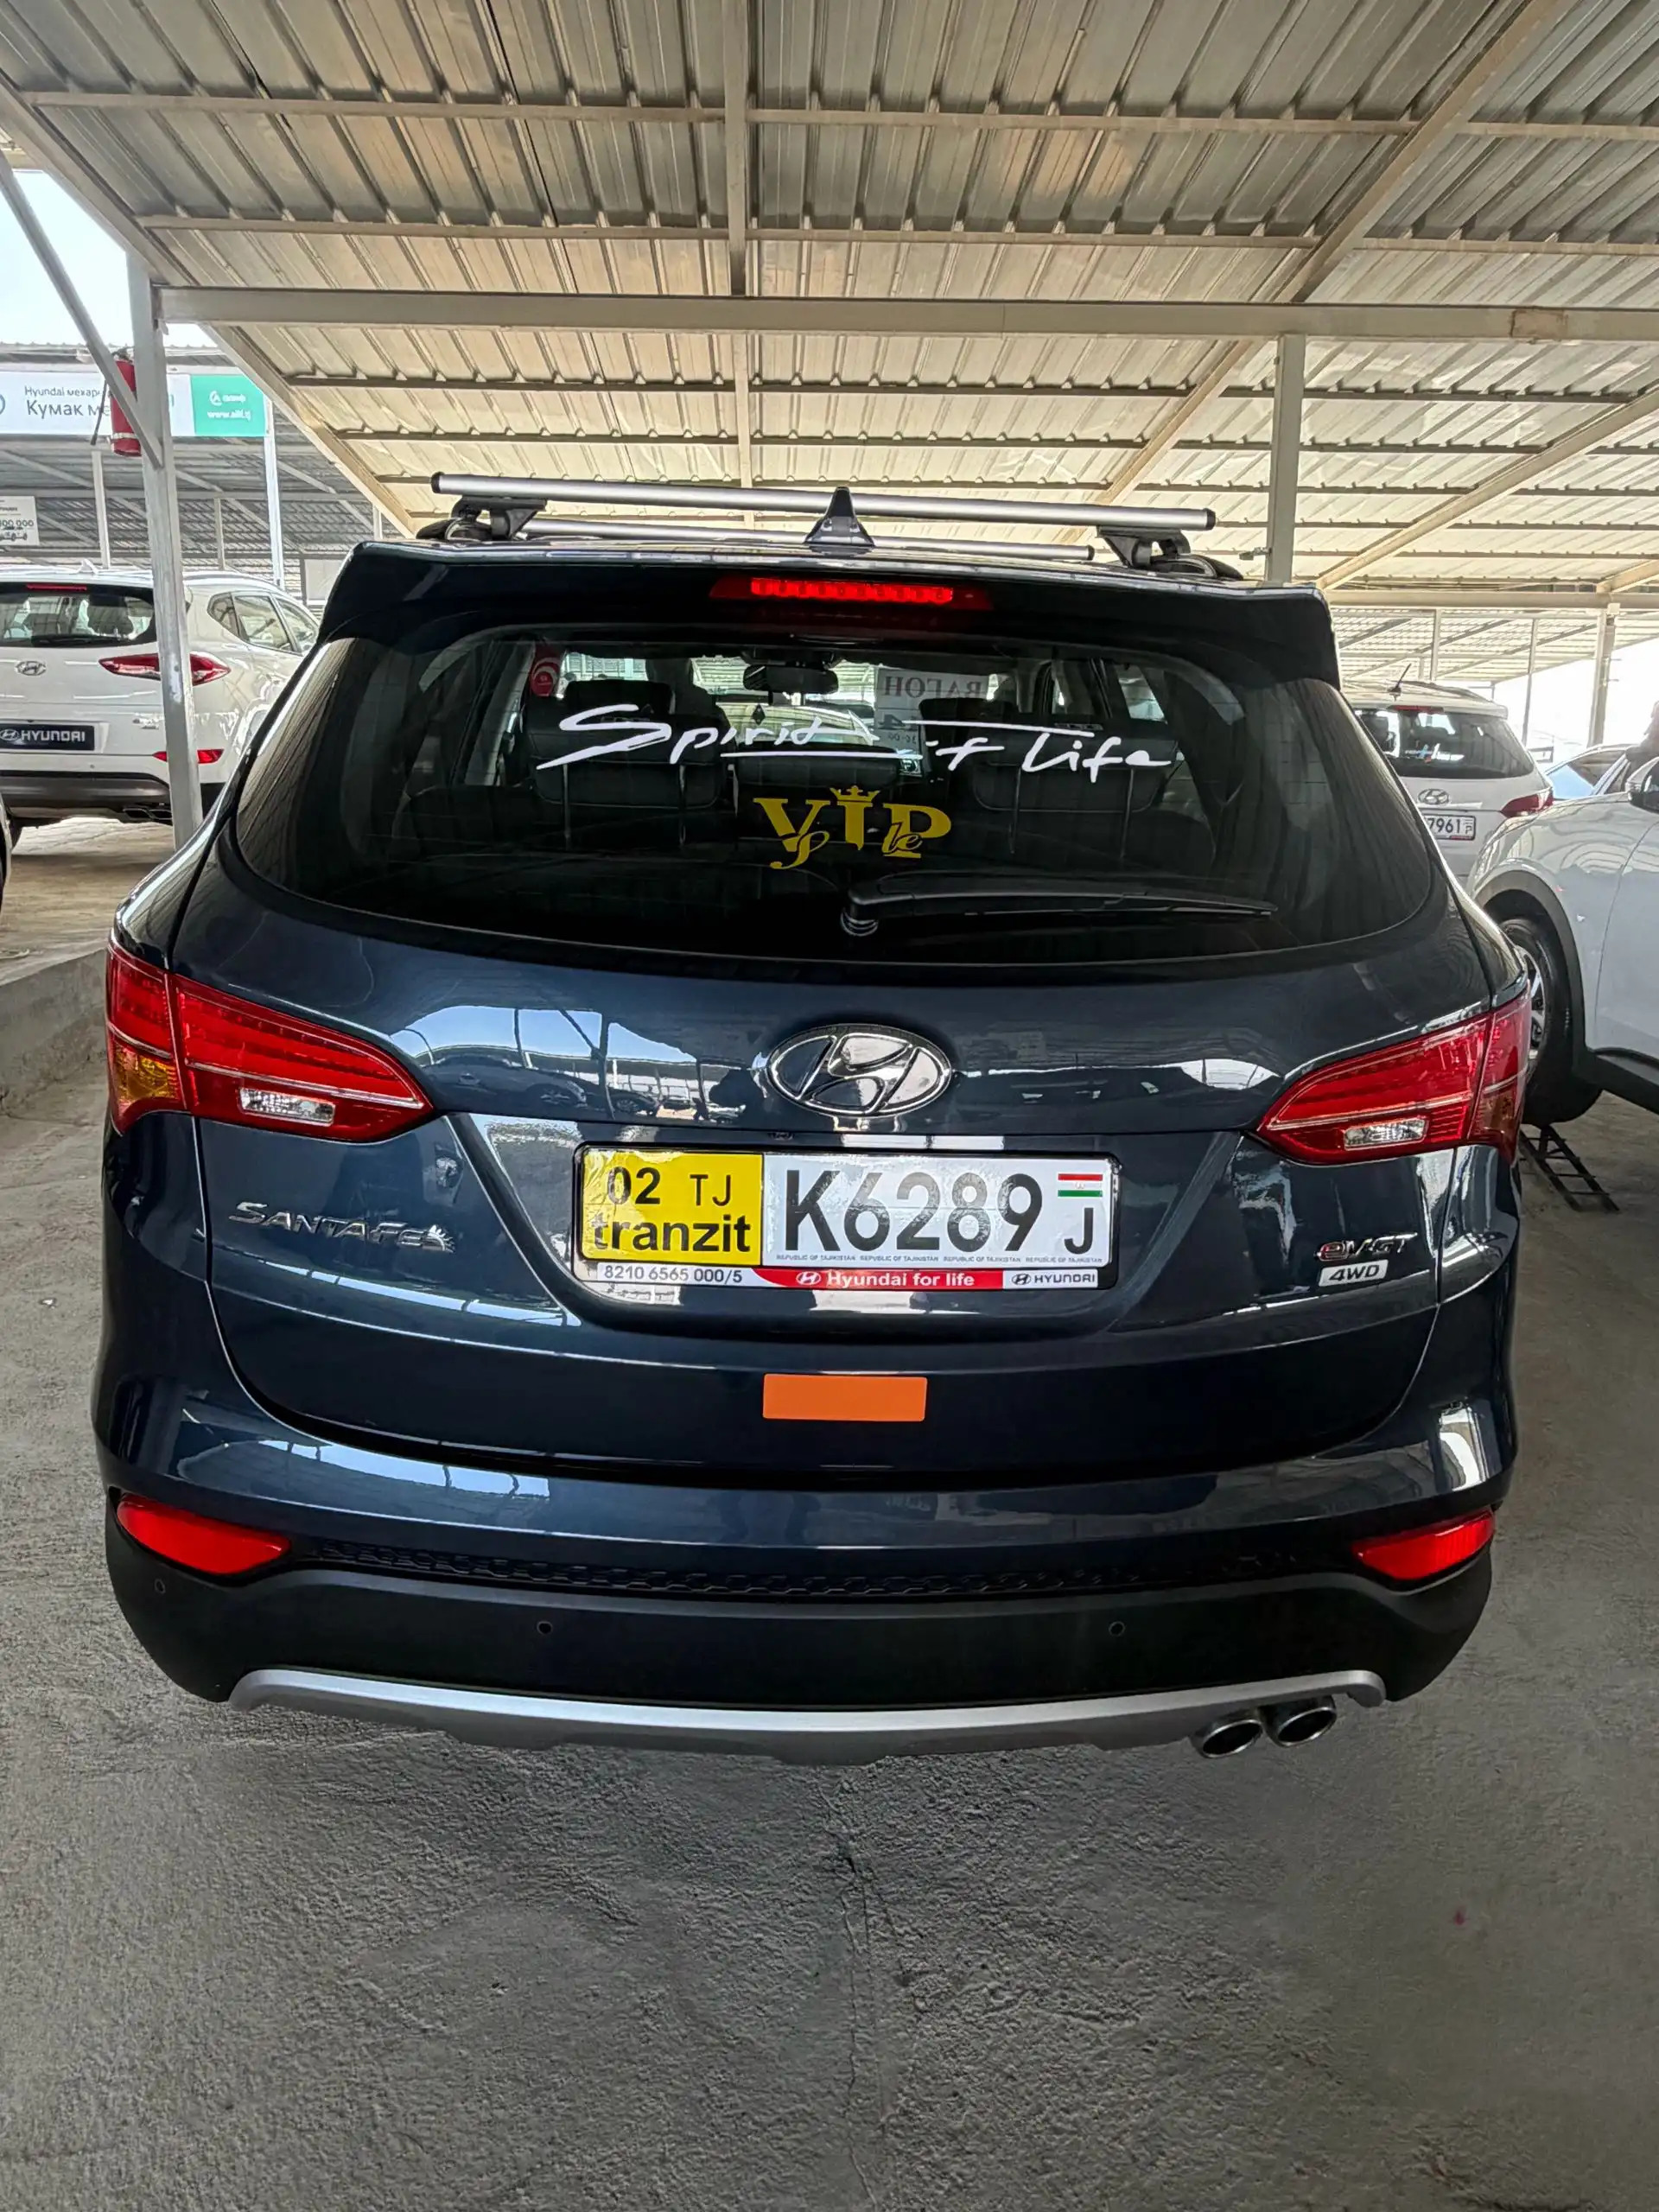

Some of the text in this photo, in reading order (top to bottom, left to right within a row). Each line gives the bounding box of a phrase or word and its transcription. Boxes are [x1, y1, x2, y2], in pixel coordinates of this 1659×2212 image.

[24, 385, 65, 397] Hyundai
[27, 399, 84, 419] Кумак
[21, 730, 86, 742] HYUNDAI
[607, 1166, 732, 1207] 02 TJ
[785, 1168, 1095, 1255] K6289 J
[591, 1213, 752, 1253] tranzit
[604, 1265, 743, 1283] 8210 6565 000/5
[827, 1269, 975, 1288] Hyundai for life
[1034, 1273, 1096, 1284] HYUNDAI
[1329, 1264, 1381, 1281] 4WD
